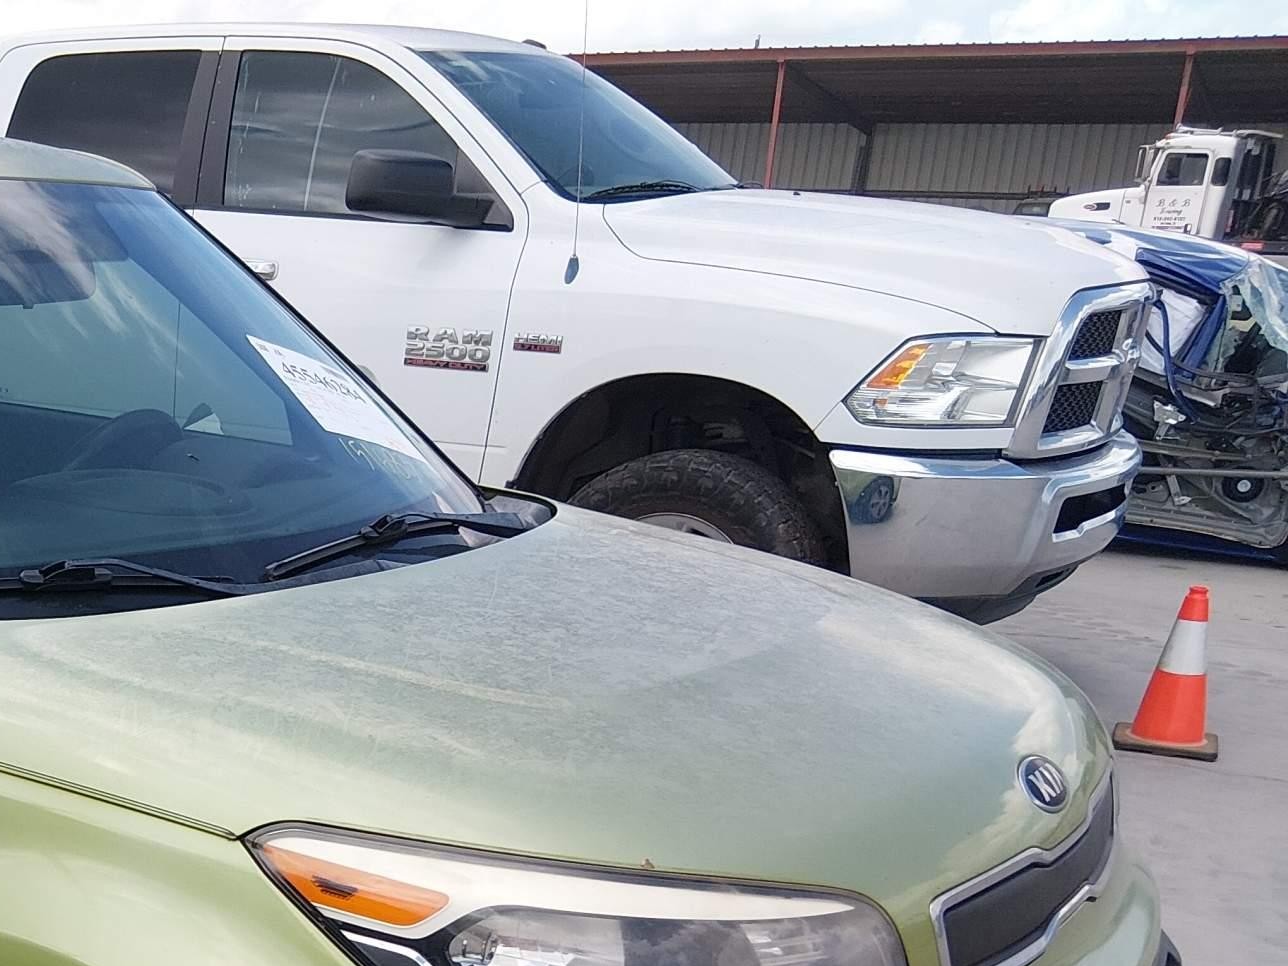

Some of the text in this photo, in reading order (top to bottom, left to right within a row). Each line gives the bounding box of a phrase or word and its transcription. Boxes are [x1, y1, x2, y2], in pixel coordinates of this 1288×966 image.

[406, 325, 493, 347] RAM
[514, 332, 563, 345] HEMI
[405, 341, 491, 363] 2500
[449, 361, 484, 371] DUTY
[1027, 762, 1064, 803] KIA
